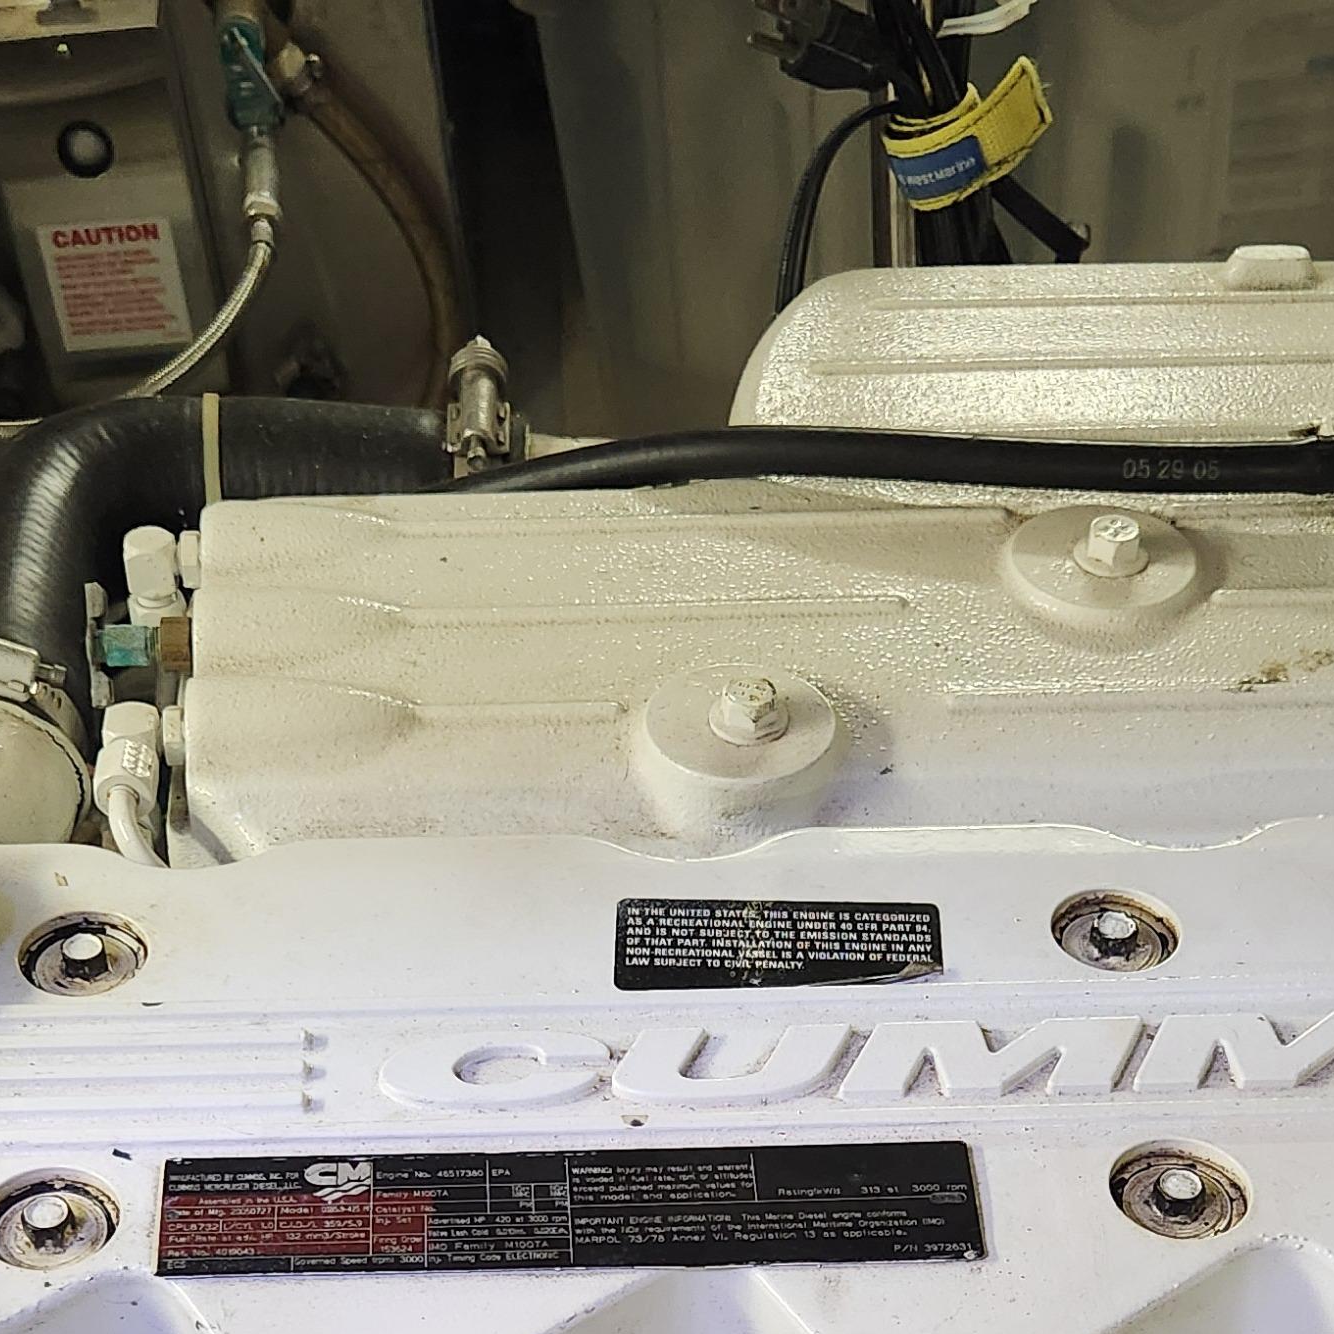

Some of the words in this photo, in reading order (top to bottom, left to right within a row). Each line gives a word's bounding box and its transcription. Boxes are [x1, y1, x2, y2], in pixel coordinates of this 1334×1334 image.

[52, 223, 160, 248] CAUTION
[1123, 459, 1150, 479] 05
[1156, 459, 1185, 479] 29
[627, 908, 640, 916] IN
[645, 908, 665, 916] THE
[670, 909, 710, 917] UNITED
[764, 911, 788, 919] THIS
[793, 911, 835, 920] ENGINE
[839, 912, 850, 920] IS
[854, 912, 931, 923] CATEGORIZED
[627, 917, 642, 926] AS
[646, 917, 655, 926] A
[659, 918, 744, 928] RECREATIONAL
[749, 920, 792, 929] ENGINE
[797, 921, 836, 930] UNDER
[840, 922, 853, 930] 40
[857, 923, 878, 931] CFR
[882, 923, 912, 932] PART
[627, 927, 652, 936] AND
[656, 928, 667, 936] IS
[671, 928, 695, 937] NOT
[699, 929, 750, 938] SUBJECT
[756, 930, 770, 938] TO
[774, 931, 796, 939] THE
[800, 931, 857, 940] EMISSION
[862, 932, 932, 942] STANDARDS
[645, 938, 673, 946] THAT
[712, 939, 792, 949] INSTALLATION
[797, 941, 811, 949] OF
[815, 942, 840, 950] THIS
[845, 942, 887, 951] ENGINE
[891, 943, 904, 951] IN
[908, 944, 932, 952] ANY
[626, 948, 734, 958] NON-RECREATIONAL
[738, 950, 778, 959] VESSEL
[796, 951, 805, 959] A
[808, 951, 865, 961] VIOLATION
[869, 953, 883, 961] OF
[886, 953, 933, 963] FEDERAL
[625, 957, 650, 966] LAW
[654, 958, 702, 967] SUBJECT
[706, 959, 720, 967] TO
[724, 959, 751, 968] CIVIL
[756, 960, 805, 970] PENALTY.
[376, 1172, 409, 1180] Engine
[912, 1184, 940, 1192] 3000
[574, 1217, 624, 1225] IMPORTANT
[455, 1242, 495, 1250] Family
[575, 1236, 621, 1244] MARPOL
[628, 1235, 664, 1243] 73/78
[894, 1244, 918, 1252] P/N
[399, 1255, 423, 1263] 3000
